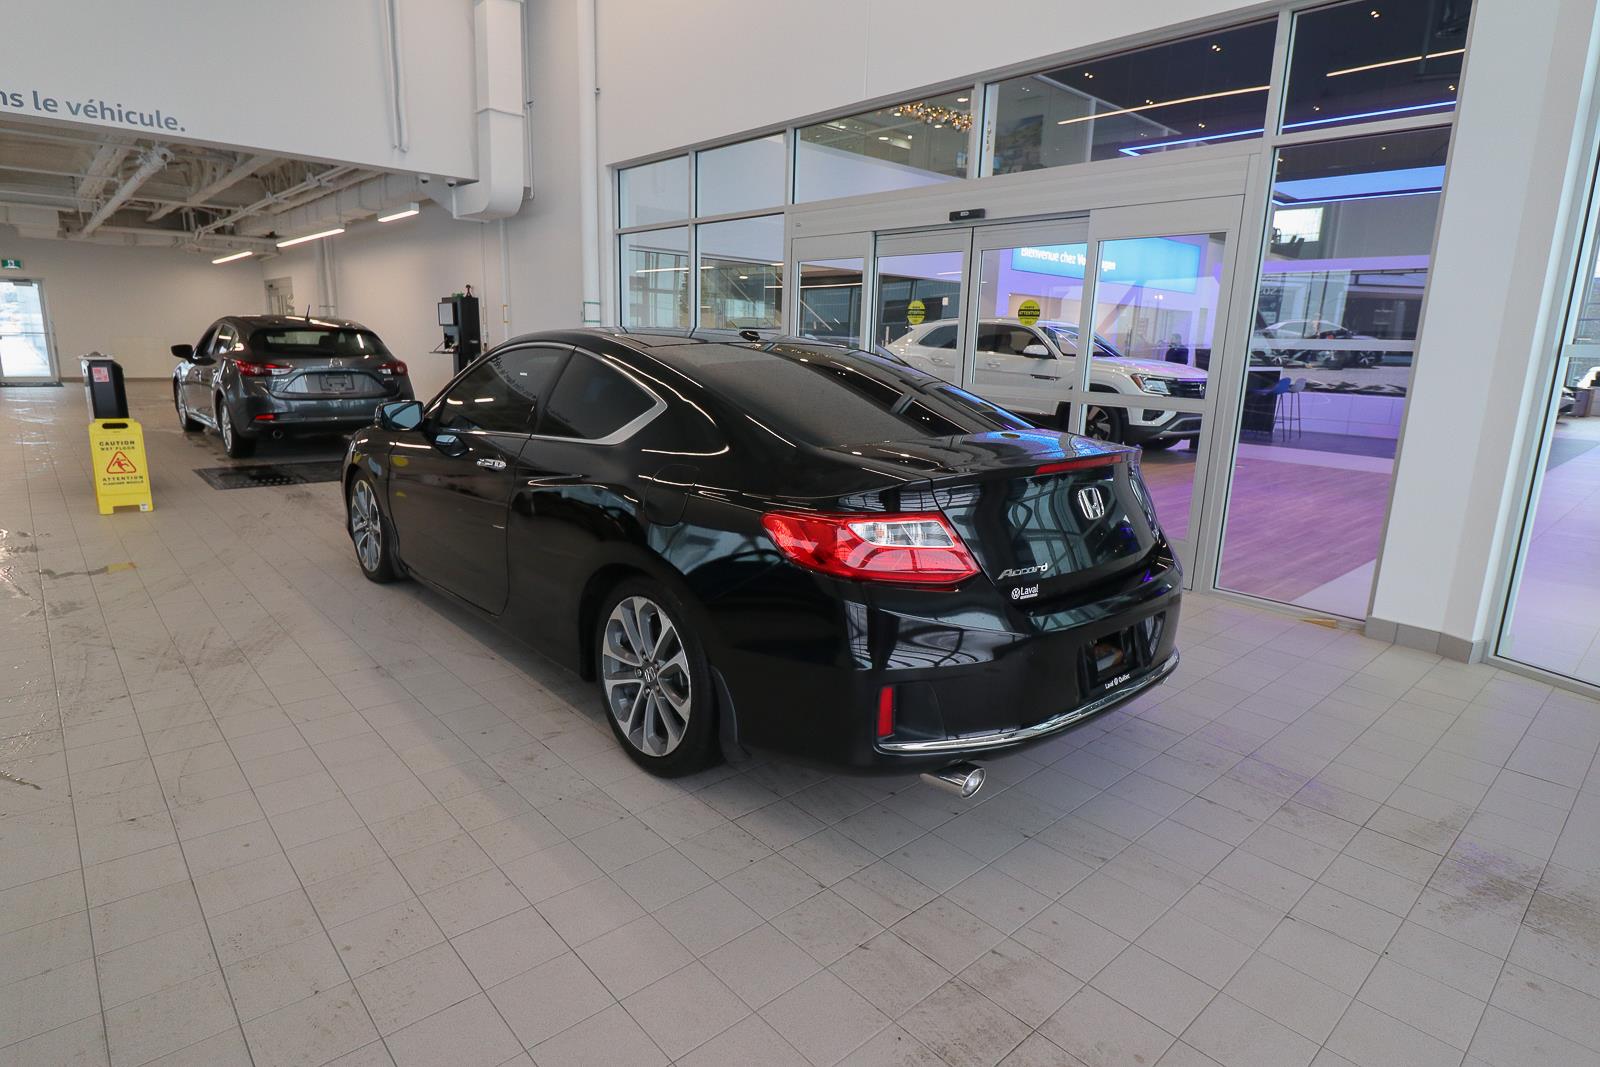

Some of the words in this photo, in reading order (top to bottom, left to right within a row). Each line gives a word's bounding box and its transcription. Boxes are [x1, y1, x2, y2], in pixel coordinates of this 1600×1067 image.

[32, 90, 58, 113] le
[65, 98, 186, 132] véhicule.
[997, 562, 1048, 580] Accord
[1020, 583, 1039, 596] Laval
